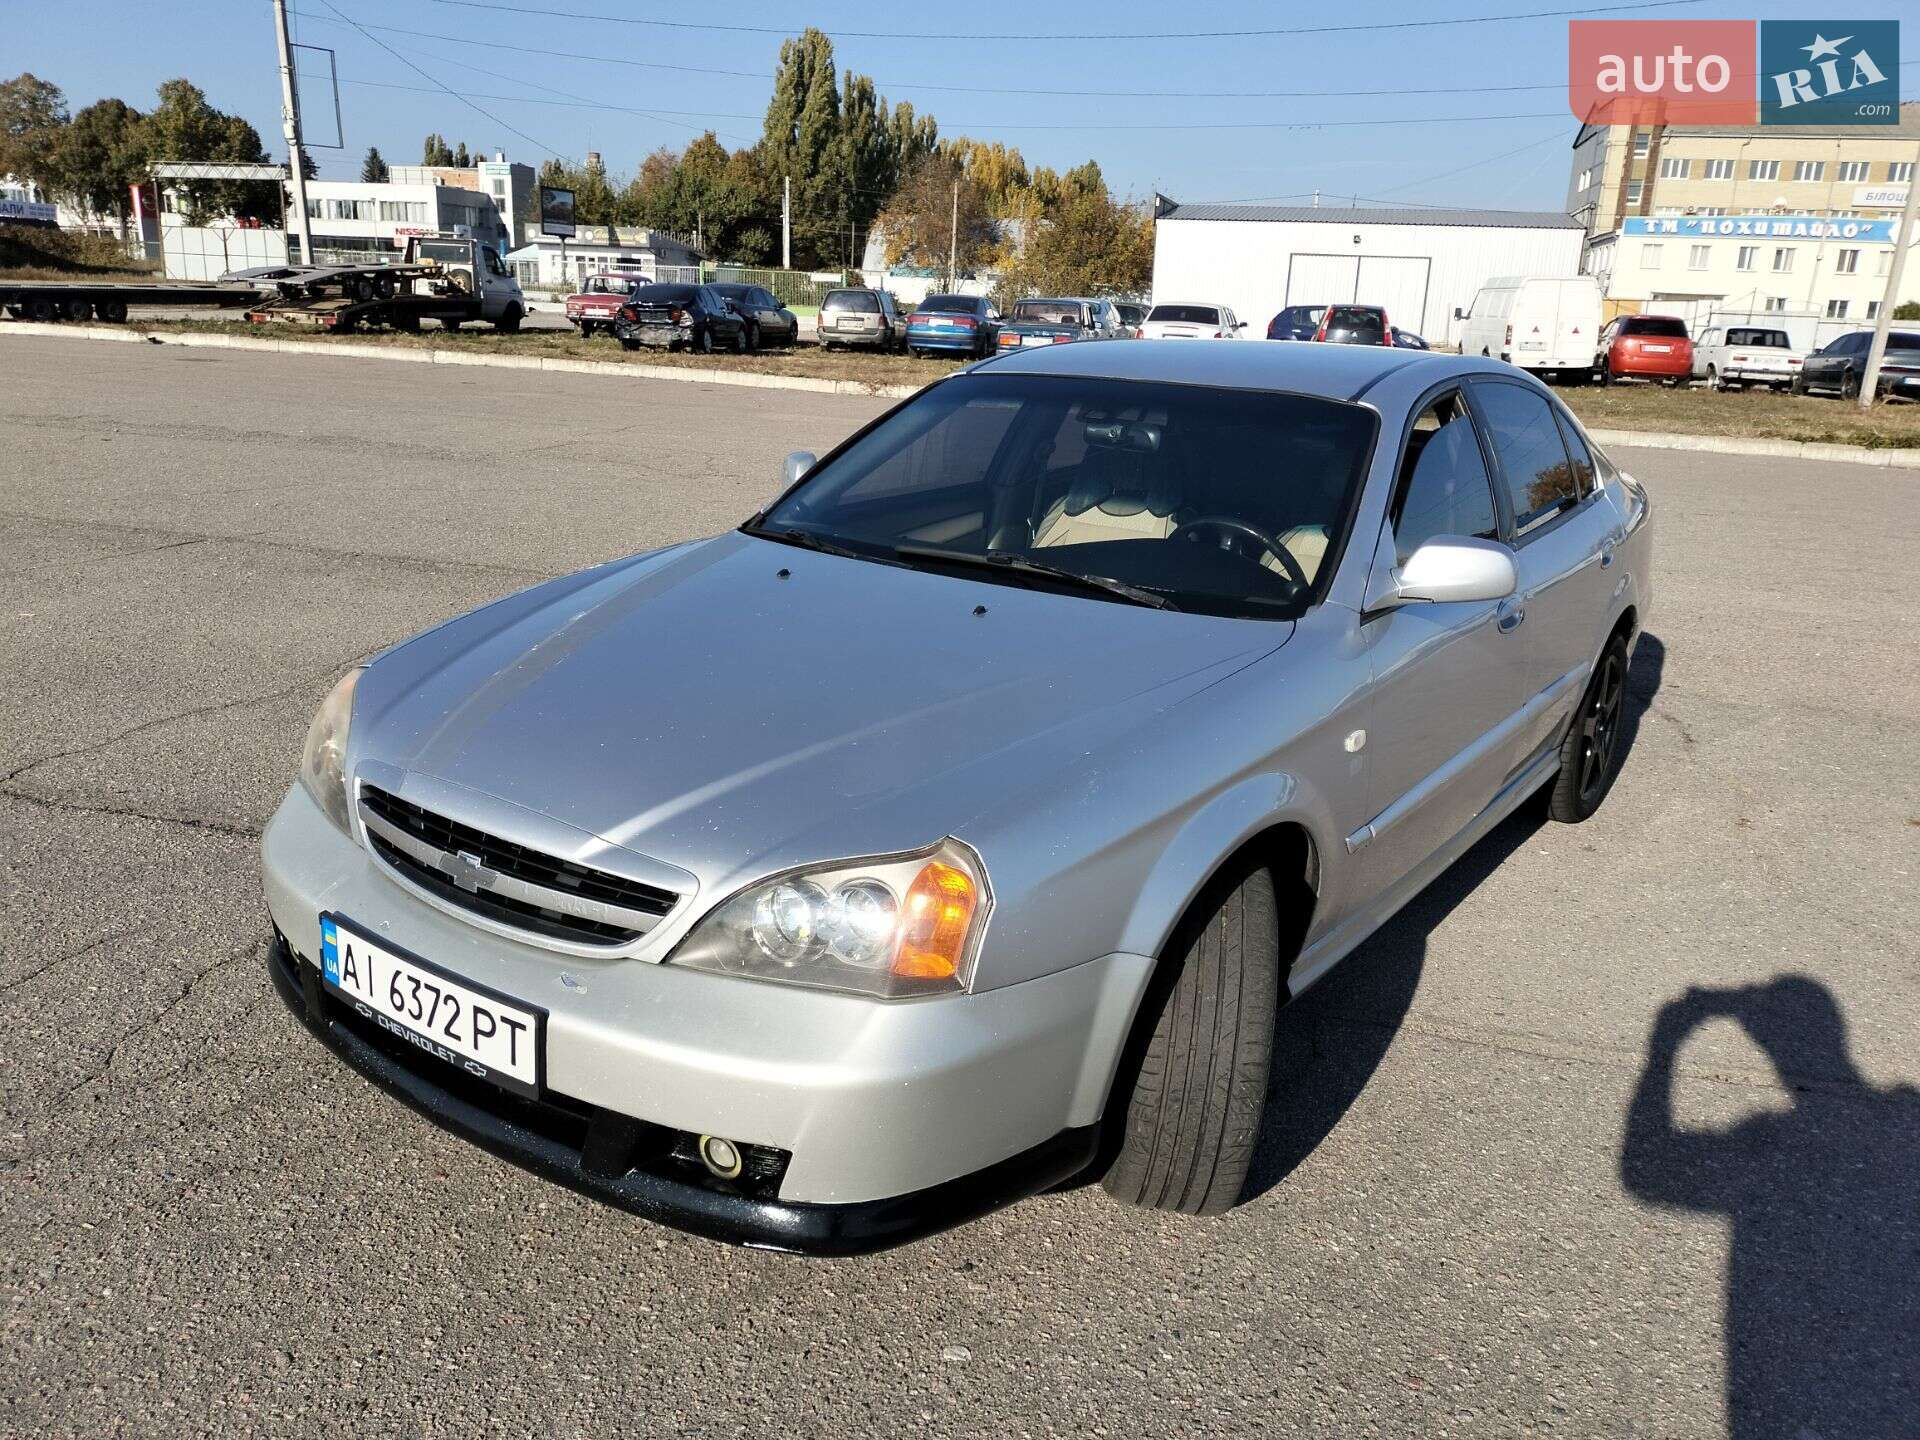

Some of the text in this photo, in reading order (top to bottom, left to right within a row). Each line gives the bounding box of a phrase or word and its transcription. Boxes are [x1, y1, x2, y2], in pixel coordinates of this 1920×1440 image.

[1865, 192, 1905, 202] БІЛОЦ
[1645, 218, 1679, 234] ТМ
[326, 958, 339, 977] UA
[343, 943, 527, 1066] AI 6372 PT
[377, 1014, 457, 1064] CHEVROLET
